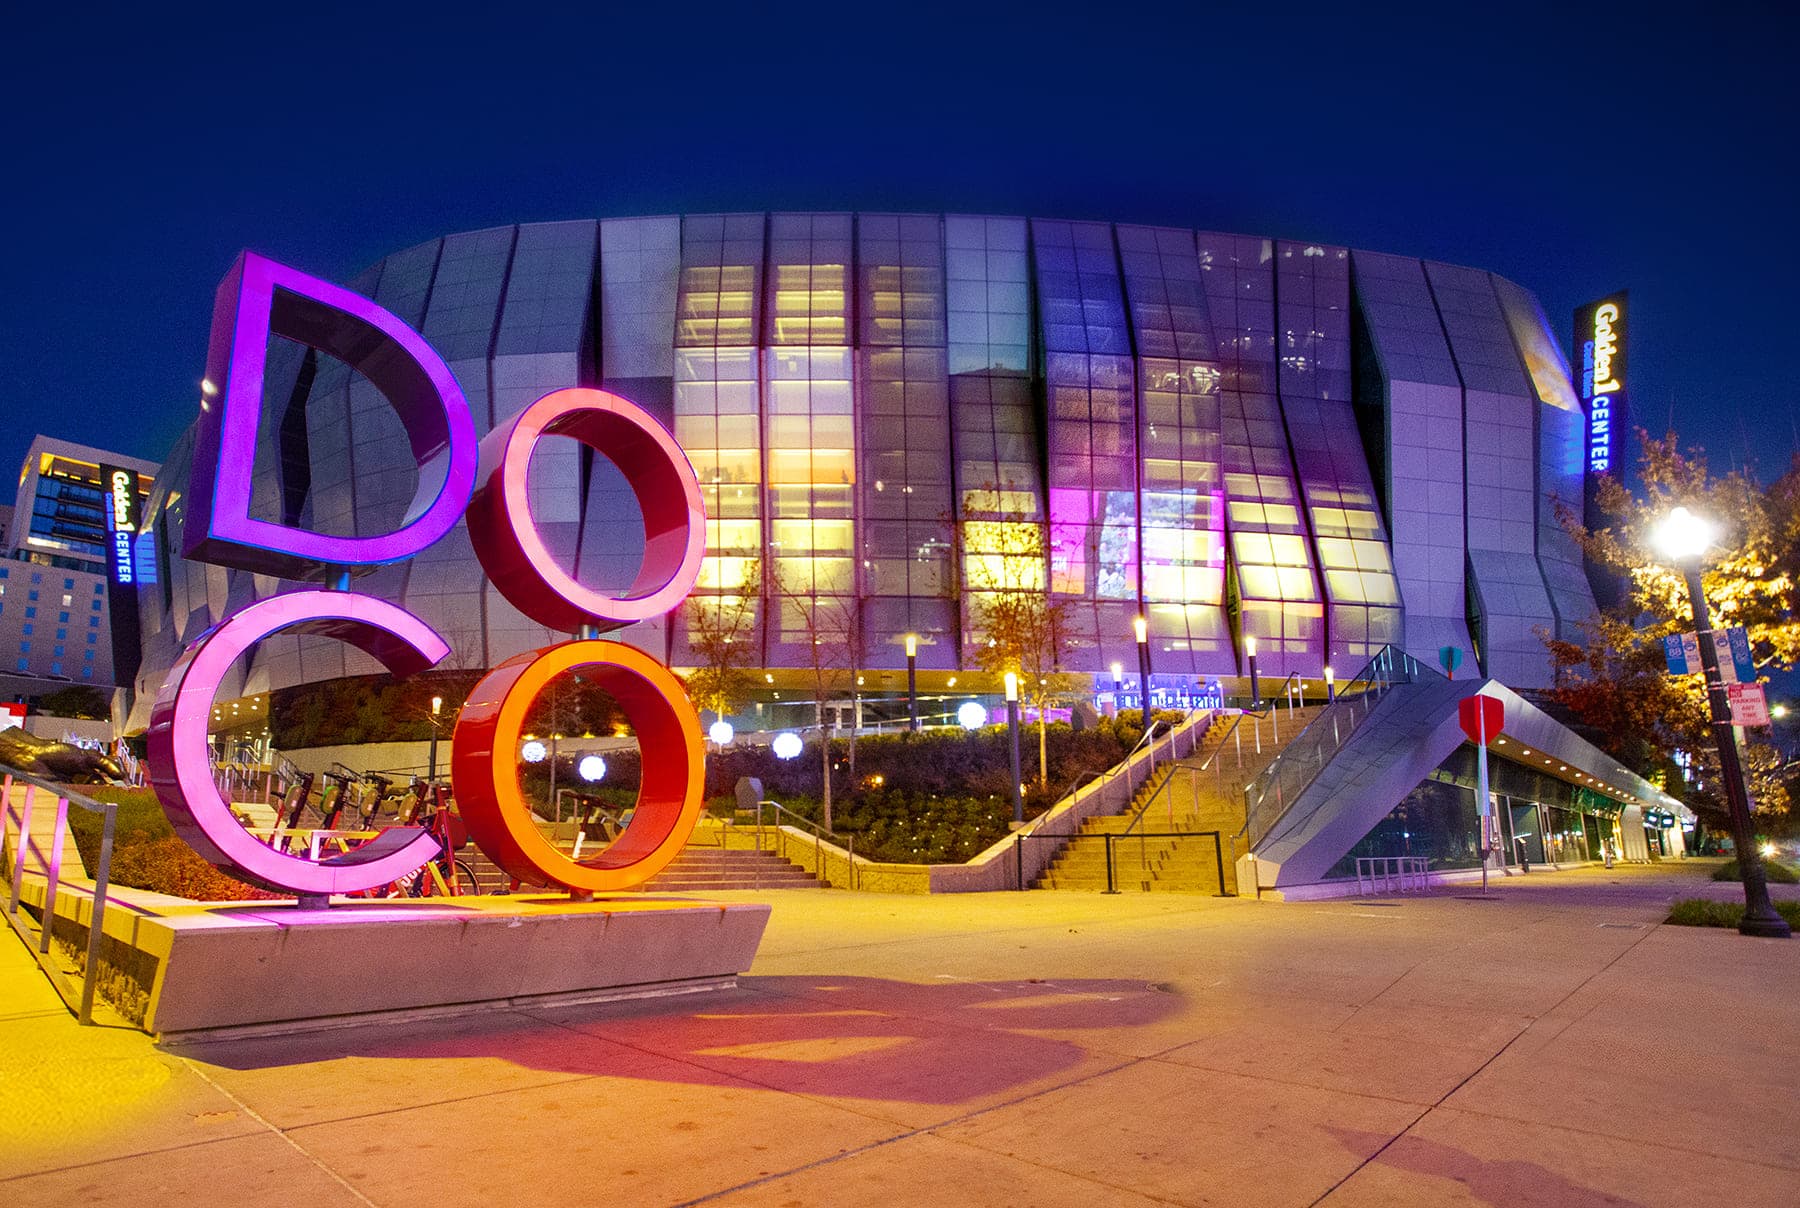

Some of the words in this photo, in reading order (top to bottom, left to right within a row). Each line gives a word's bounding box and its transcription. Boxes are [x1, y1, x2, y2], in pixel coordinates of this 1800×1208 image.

[1594, 303, 1618, 381] Golden
[1591, 397, 1610, 472] CENTER
[115, 532, 131, 583] CENTER
[1732, 697, 1761, 705] PARKING
